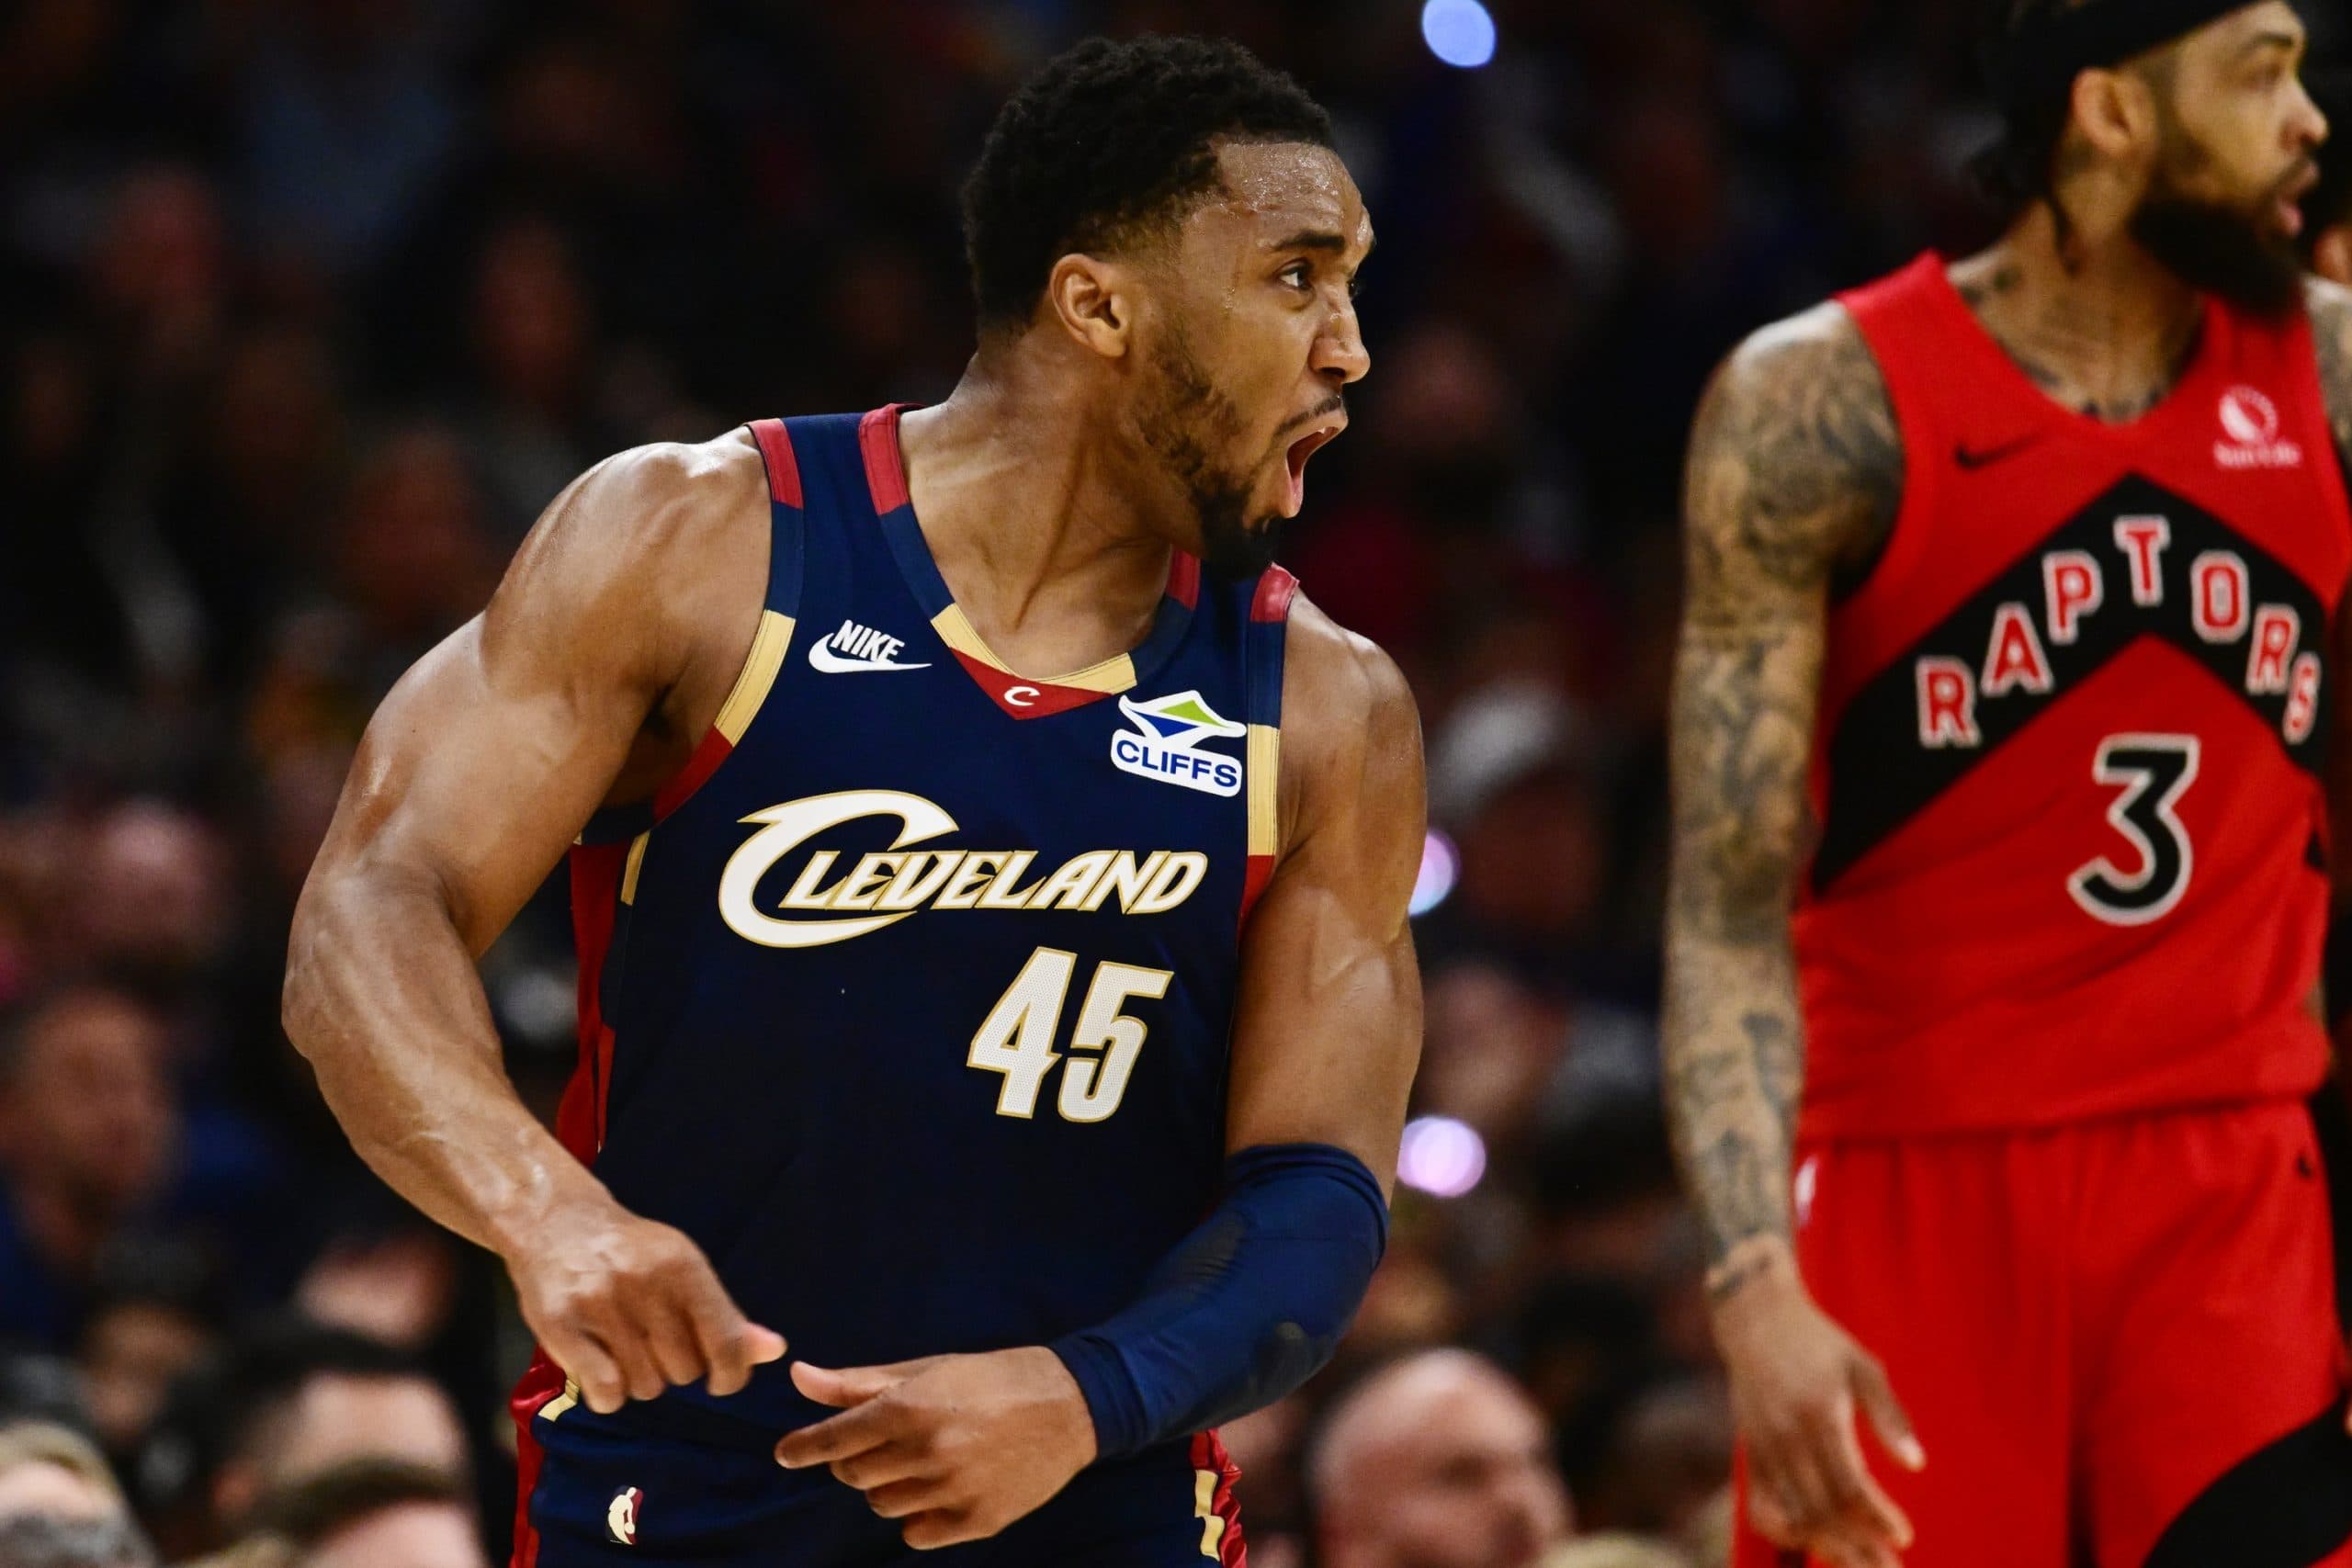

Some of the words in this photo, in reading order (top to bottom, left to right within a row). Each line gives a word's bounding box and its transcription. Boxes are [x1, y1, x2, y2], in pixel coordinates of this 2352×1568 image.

[830, 619, 905, 662] NIKE
[1004, 685, 1040, 705] C
[1917, 515, 2321, 747] RAPTORS
[1116, 739, 1238, 787] CLIFFS
[2067, 733, 2200, 926] 3
[718, 789, 1207, 948] CLEVELAND
[967, 946, 1174, 1122] 45
